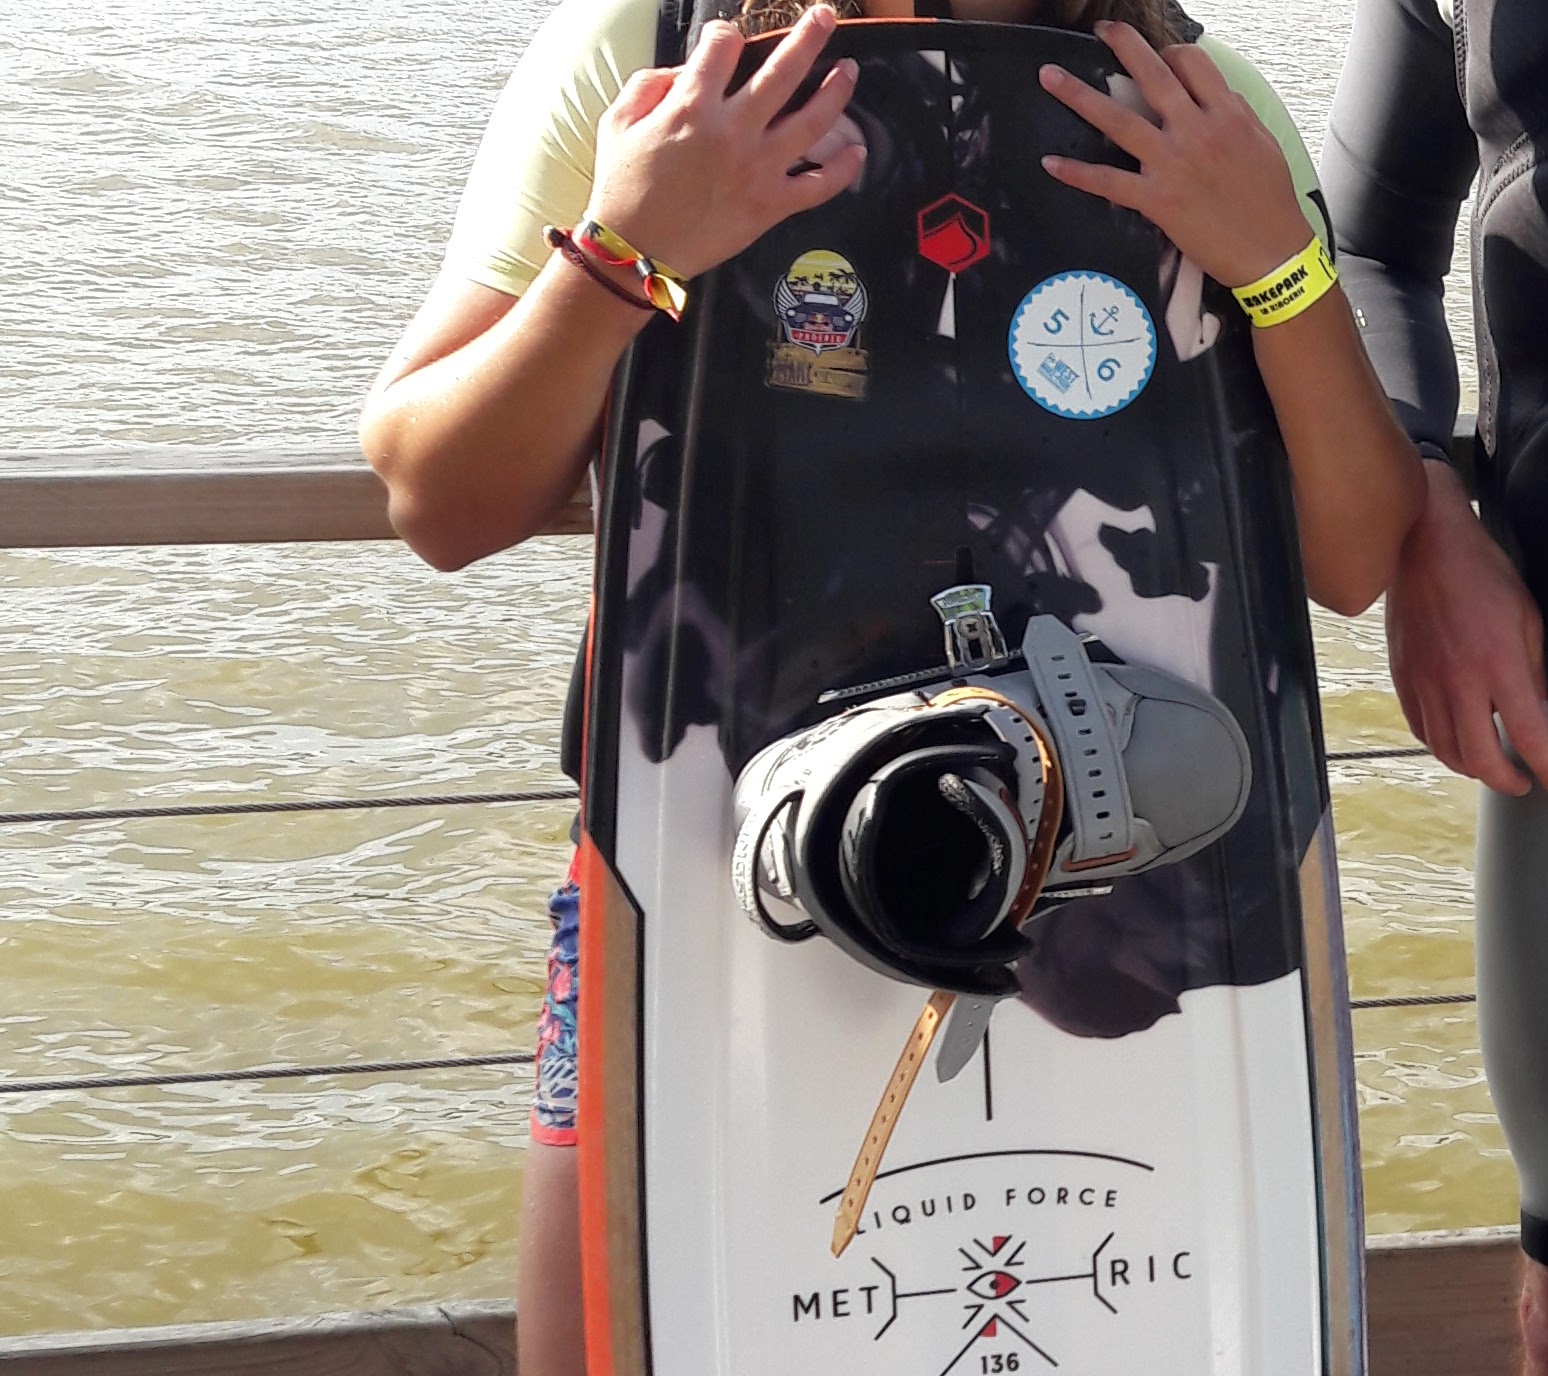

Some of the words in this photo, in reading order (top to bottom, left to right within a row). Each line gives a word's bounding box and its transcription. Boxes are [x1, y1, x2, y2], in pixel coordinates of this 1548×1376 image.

[1043, 308, 1070, 335] 5
[1097, 358, 1121, 382] 6
[1005, 1187, 1119, 1208] FORCE
[980, 1353, 1020, 1376] 136
